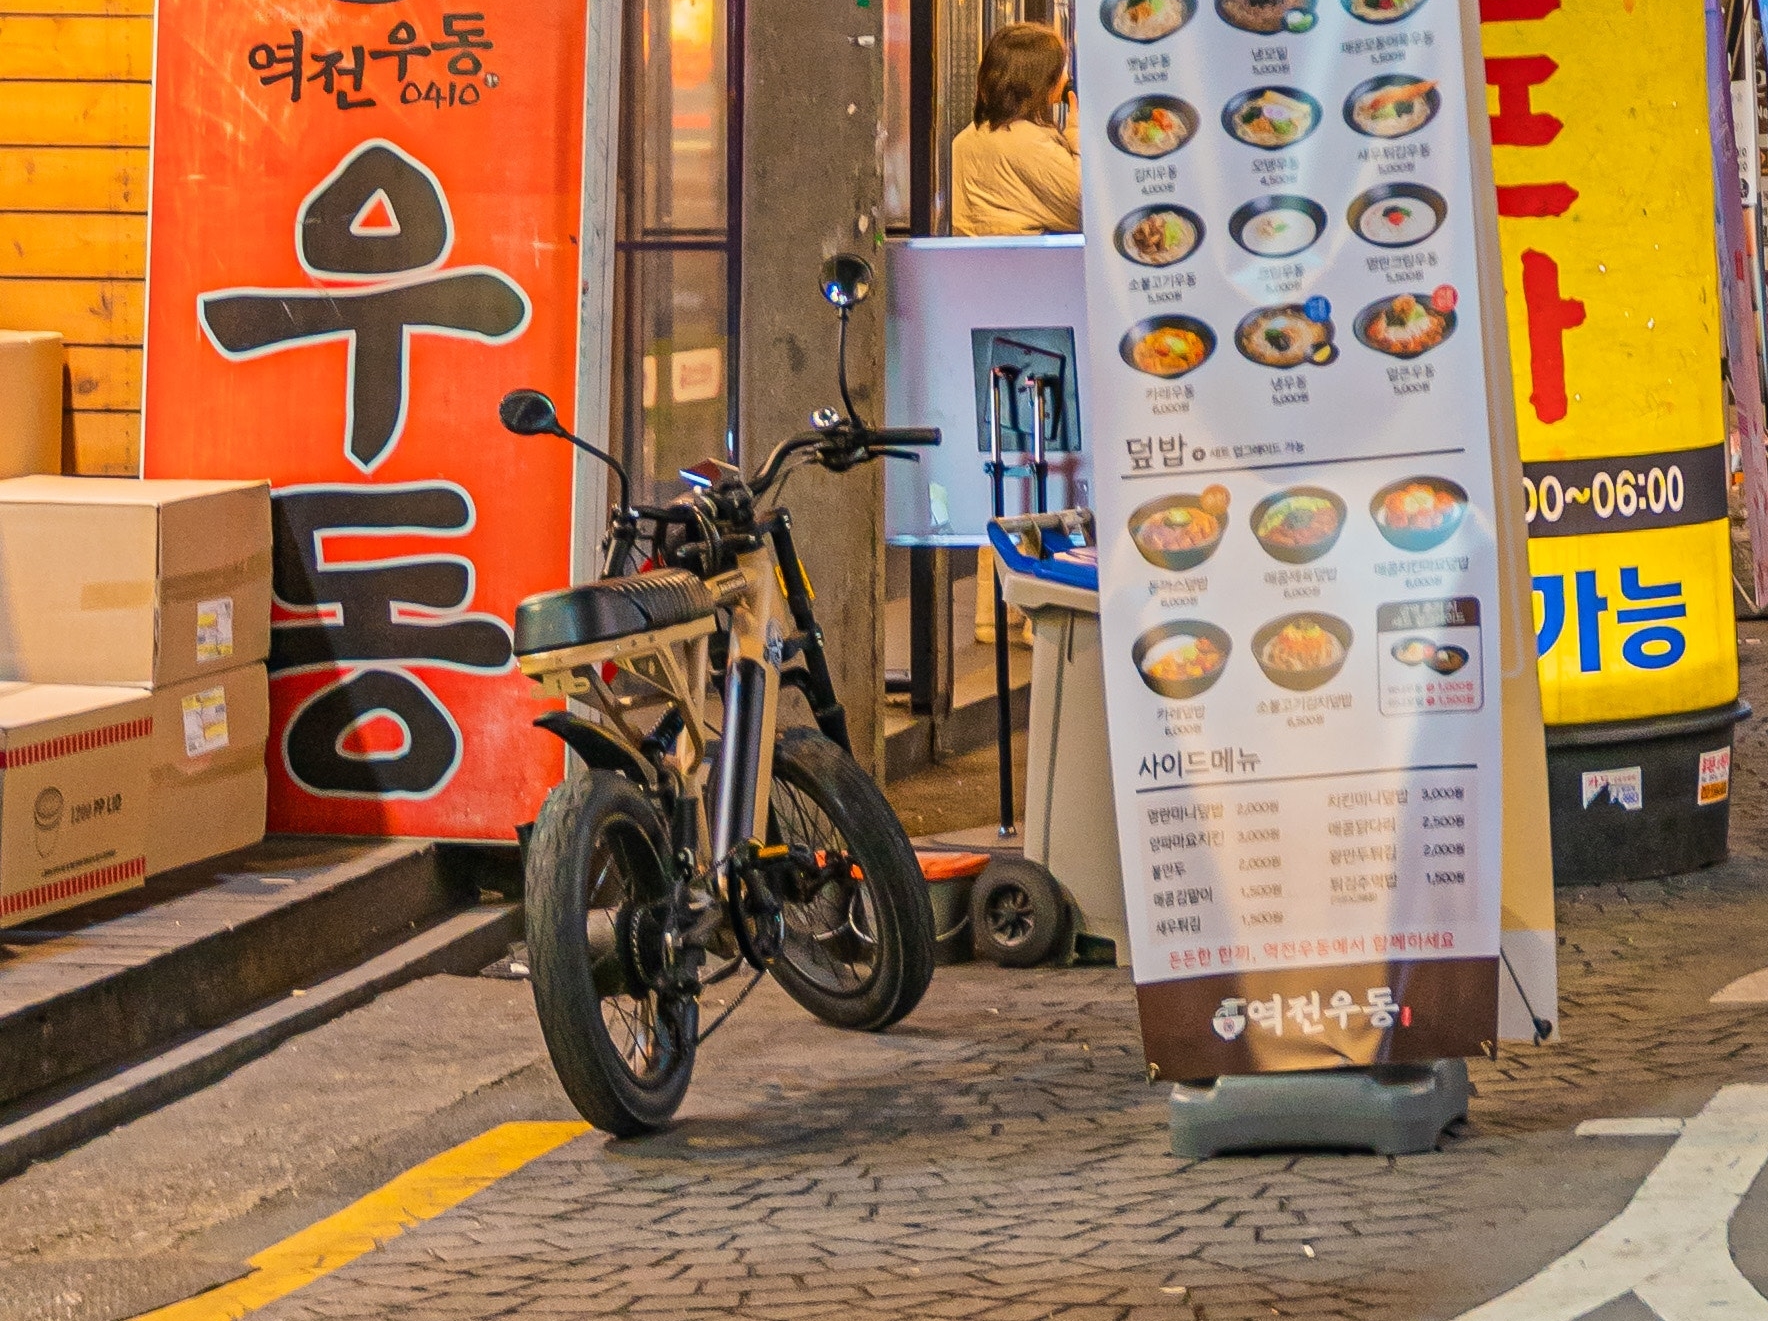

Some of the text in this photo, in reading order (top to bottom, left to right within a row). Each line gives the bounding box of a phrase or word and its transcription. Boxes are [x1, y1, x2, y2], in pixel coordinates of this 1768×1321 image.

[248, 12, 493, 110] 역전우동
[400, 81, 481, 108] 0410
[199, 139, 532, 800] 우동
[1126, 433, 1188, 471] 덮밥
[1531, 565, 1687, 674] 가능
[1138, 747, 1262, 781] 사이드메뉴
[1246, 985, 1401, 1039] 역전우동
